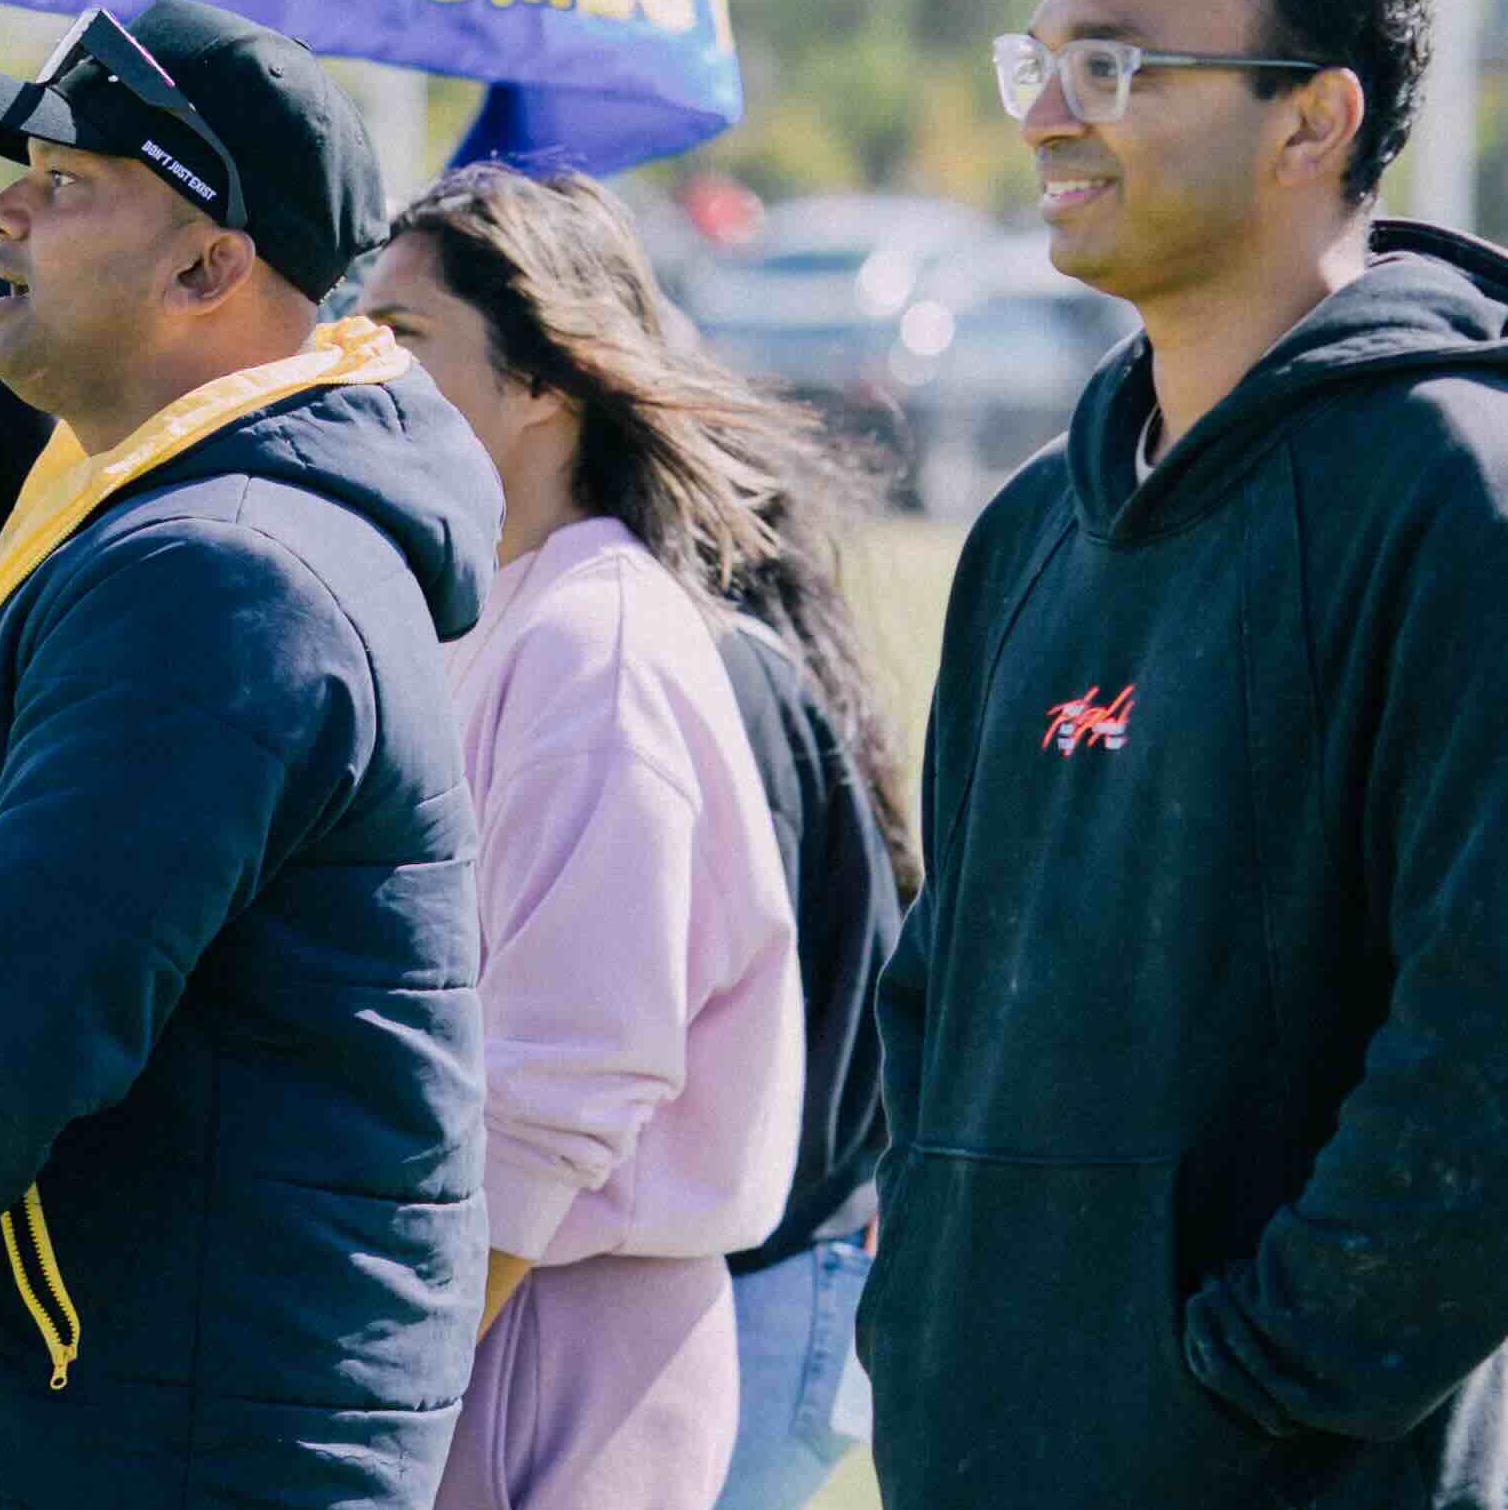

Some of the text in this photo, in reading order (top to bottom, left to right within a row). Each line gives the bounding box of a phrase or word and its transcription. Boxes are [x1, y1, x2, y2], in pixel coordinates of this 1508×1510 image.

[140, 139, 218, 201] DON'T JUST EXIST
